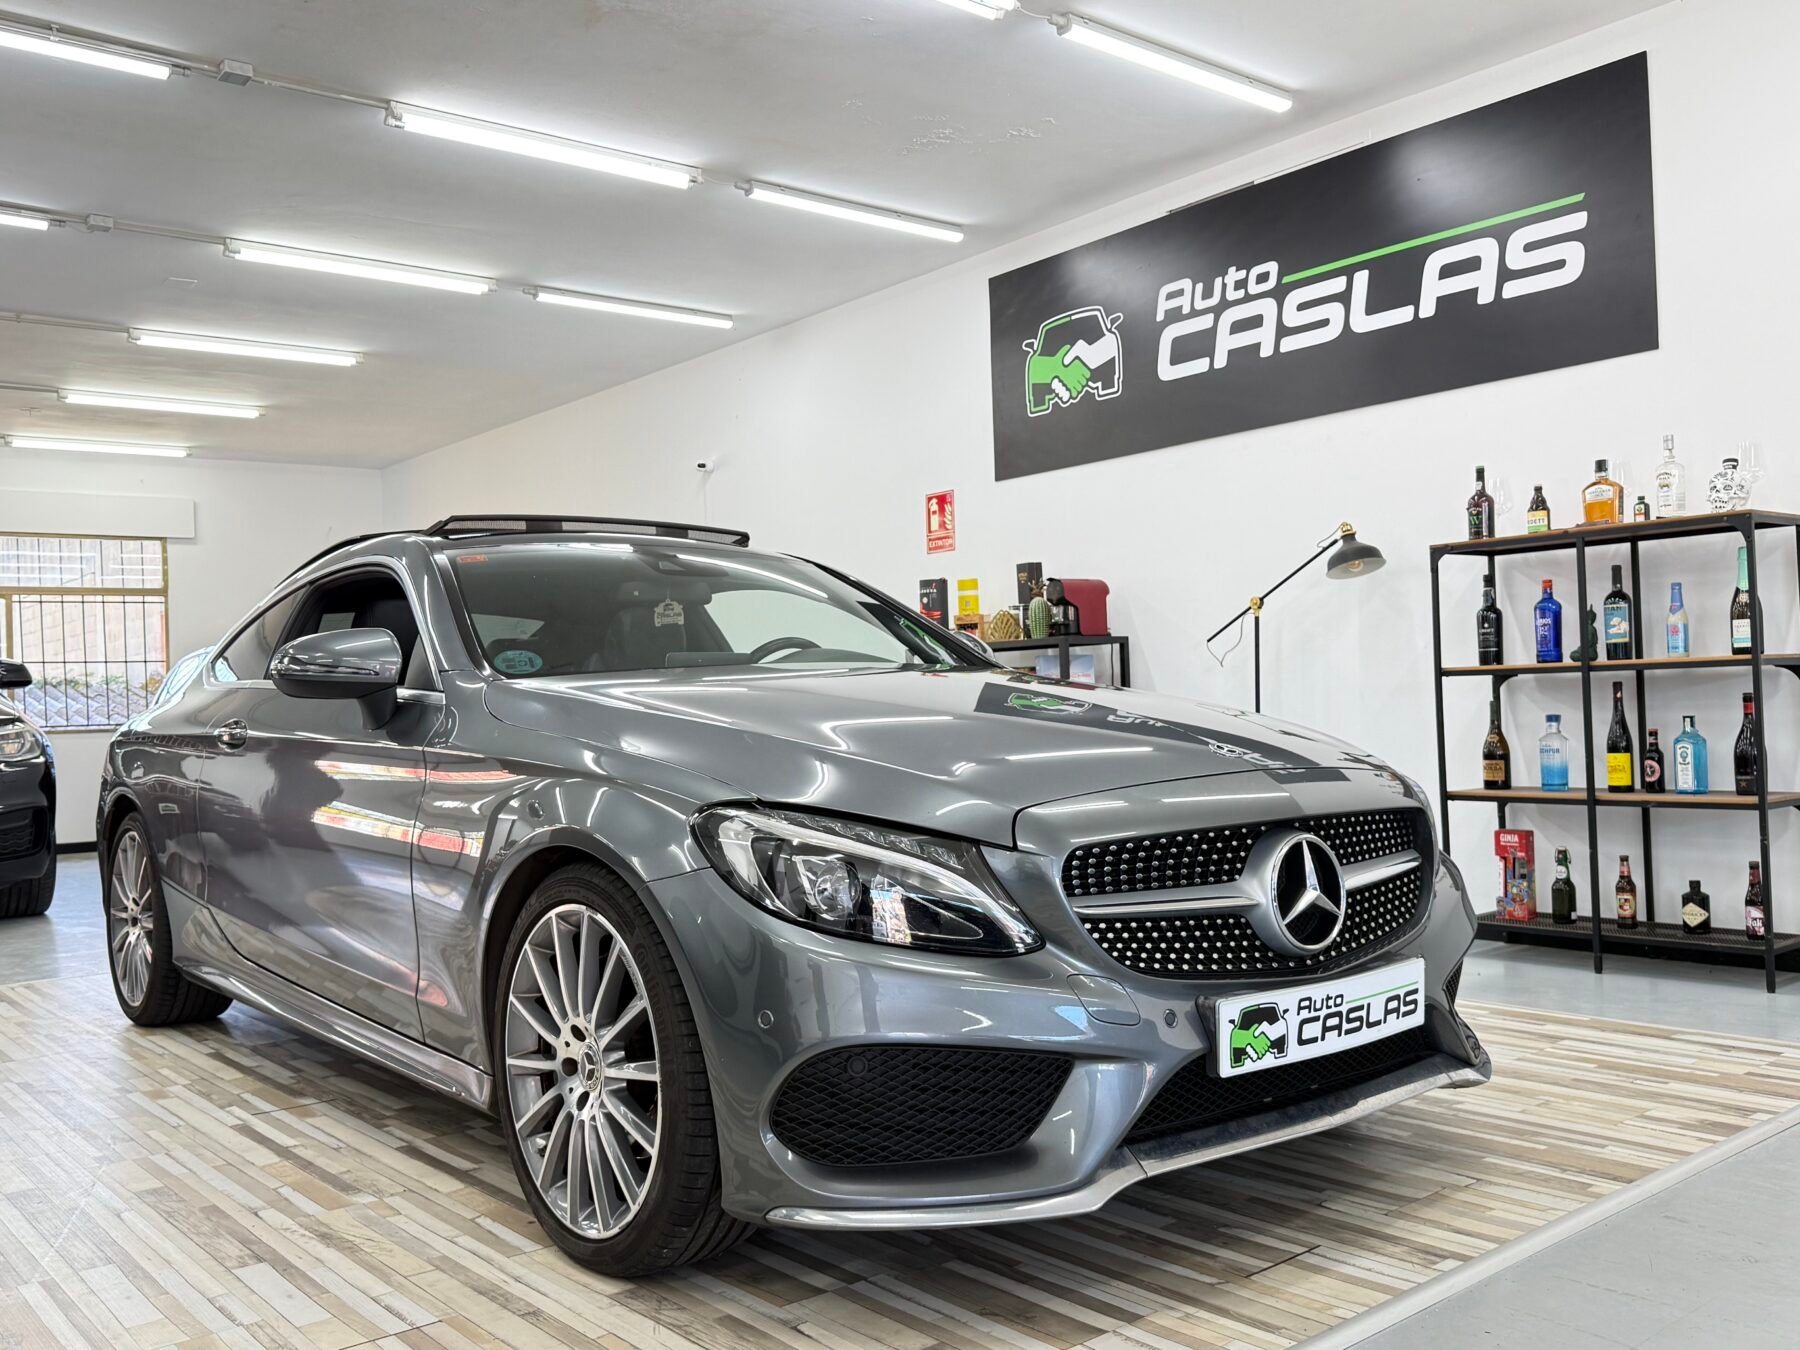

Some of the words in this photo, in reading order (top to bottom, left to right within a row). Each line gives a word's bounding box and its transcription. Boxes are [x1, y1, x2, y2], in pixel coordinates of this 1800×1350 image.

[1156, 259, 1280, 323] Auto
[1157, 210, 1588, 381] CASLAS
[929, 538, 953, 548] EXTINTOR
[1499, 833, 1519, 842] GINJA
[1297, 993, 1345, 1016] Auto
[1297, 988, 1419, 1046] CASLAS
